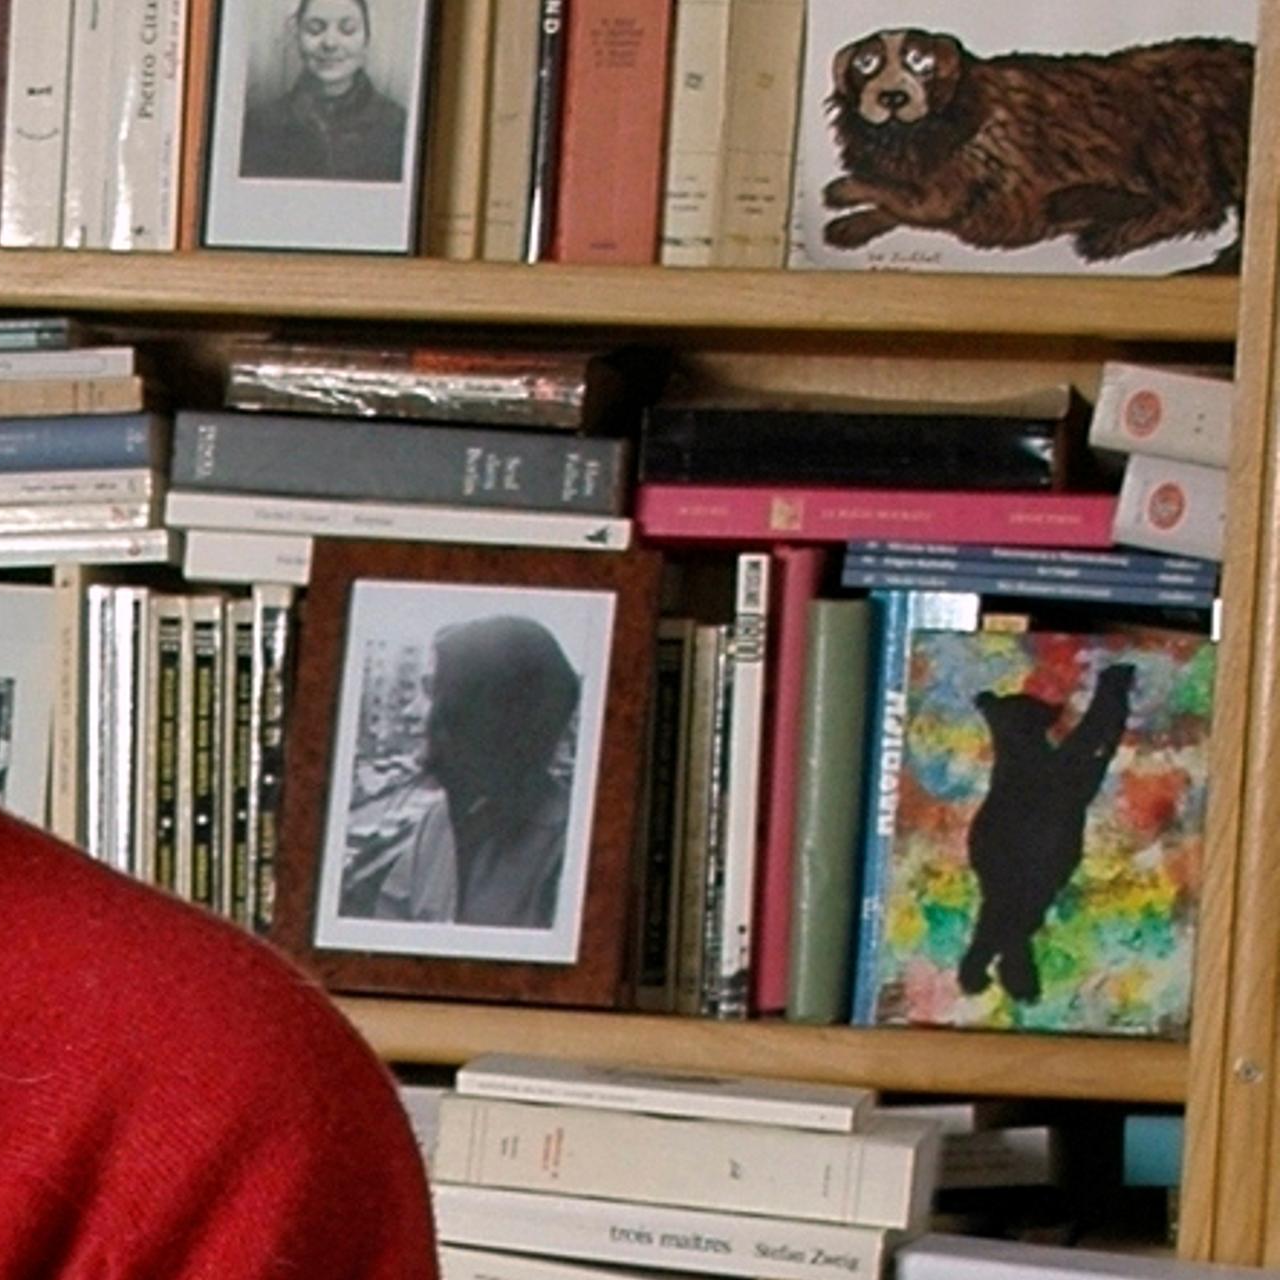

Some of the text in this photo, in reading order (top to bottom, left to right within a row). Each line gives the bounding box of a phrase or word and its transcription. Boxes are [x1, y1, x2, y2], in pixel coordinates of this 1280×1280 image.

[609, 1225, 860, 1272] trois maîtres Stefan Zweig
